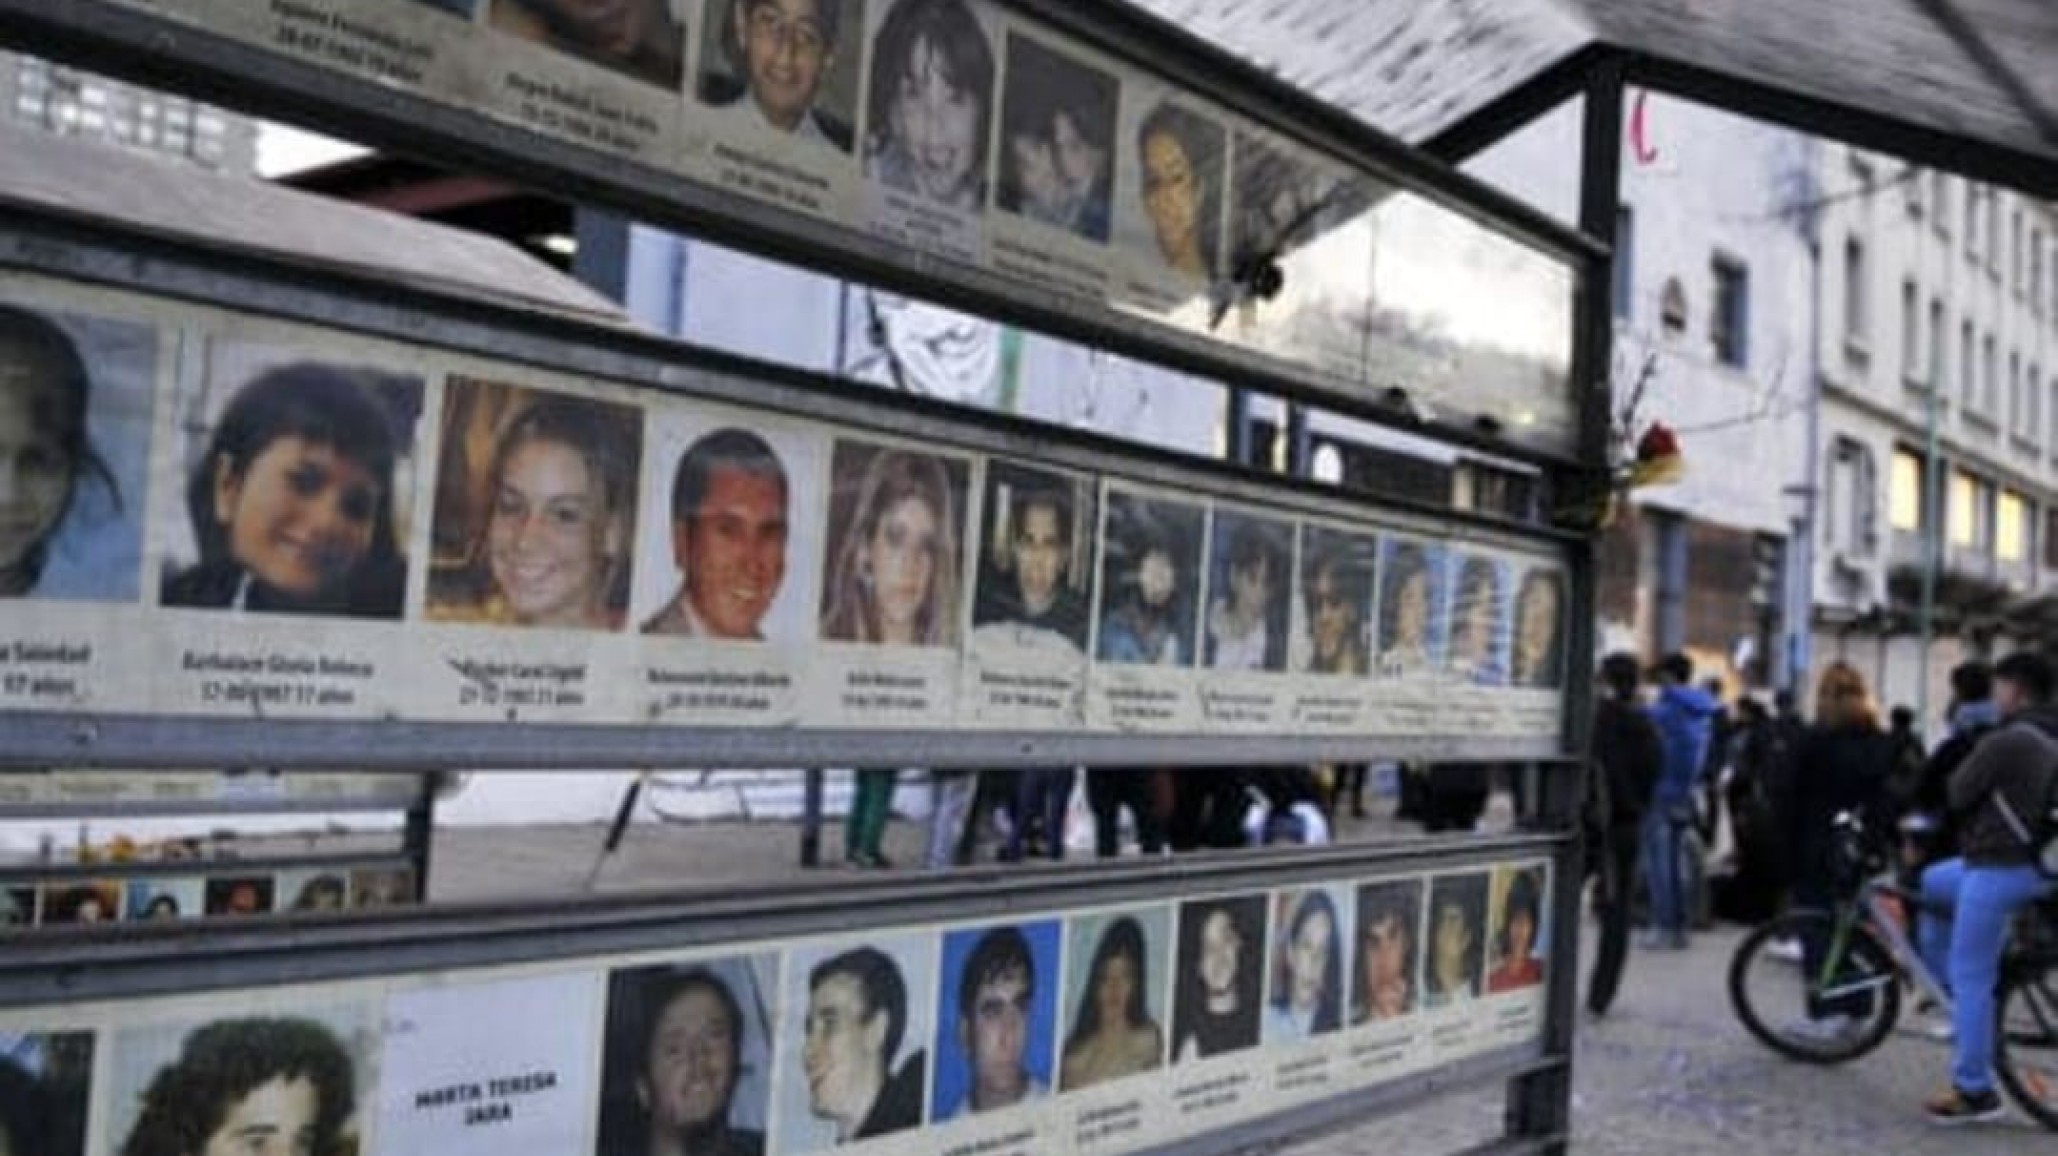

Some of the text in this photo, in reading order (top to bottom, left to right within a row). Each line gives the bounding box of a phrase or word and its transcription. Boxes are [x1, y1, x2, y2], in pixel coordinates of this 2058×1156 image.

[415, 1071, 557, 1108] MARTA TERESA
[464, 1103, 512, 1125] JARA
